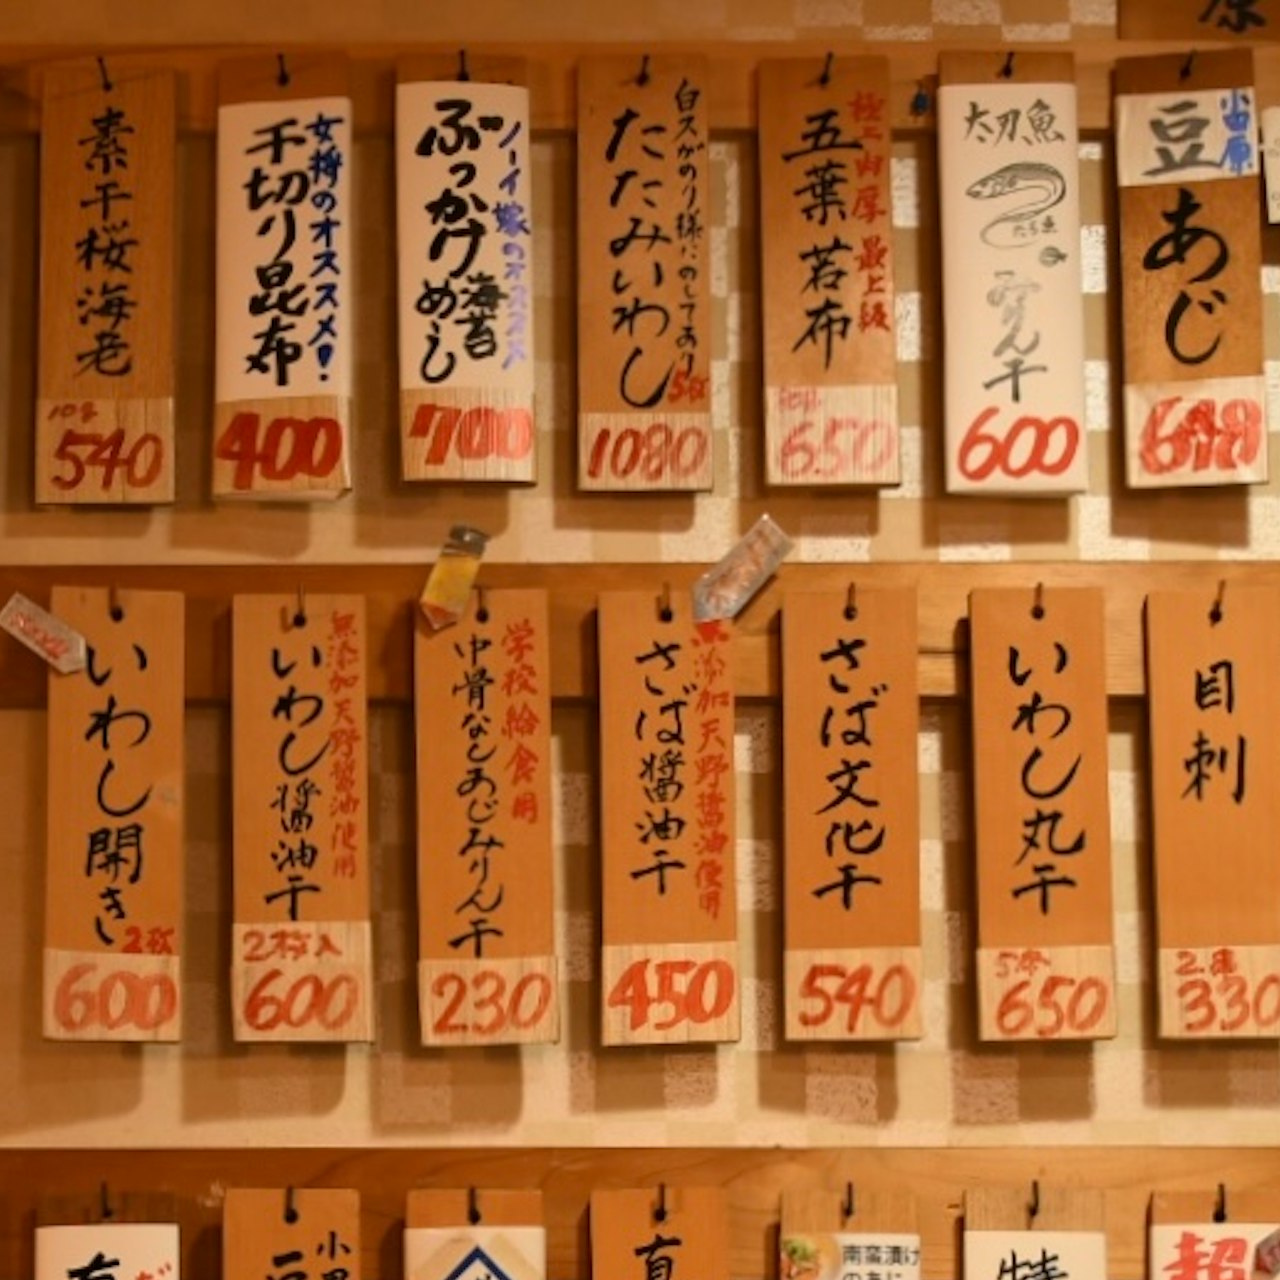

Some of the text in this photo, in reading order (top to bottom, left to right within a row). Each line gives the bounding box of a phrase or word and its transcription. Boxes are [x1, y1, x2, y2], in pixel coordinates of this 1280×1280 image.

[1143, 101, 1223, 176] 豆
[73, 105, 140, 379] 素干桜海老
[604, 107, 673, 409] たたみいわし
[782, 107, 863, 372] 五葉若布
[1142, 188, 1230, 366] あじ
[51, 427, 163, 492] 540
[216, 411, 342, 491] 400
[408, 402, 532, 466] 700
[587, 424, 708, 480] 1080
[778, 418, 897, 475] 650
[958, 408, 1081, 481] 600
[630, 641, 698, 895] さば醤油干
[1181, 659, 1248, 804] 目刺
[82, 643, 156, 947] いわし開き
[265, 645, 331, 921] いわし醤油干
[810, 638, 888, 911] さば文化干
[1008, 642, 1087, 915] いわし丸干
[54, 963, 176, 1031] 600
[243, 968, 362, 1032] 600
[430, 972, 550, 1034] 230
[608, 960, 735, 1030] 450
[799, 965, 916, 1032] 540
[996, 976, 1108, 1036] 650
